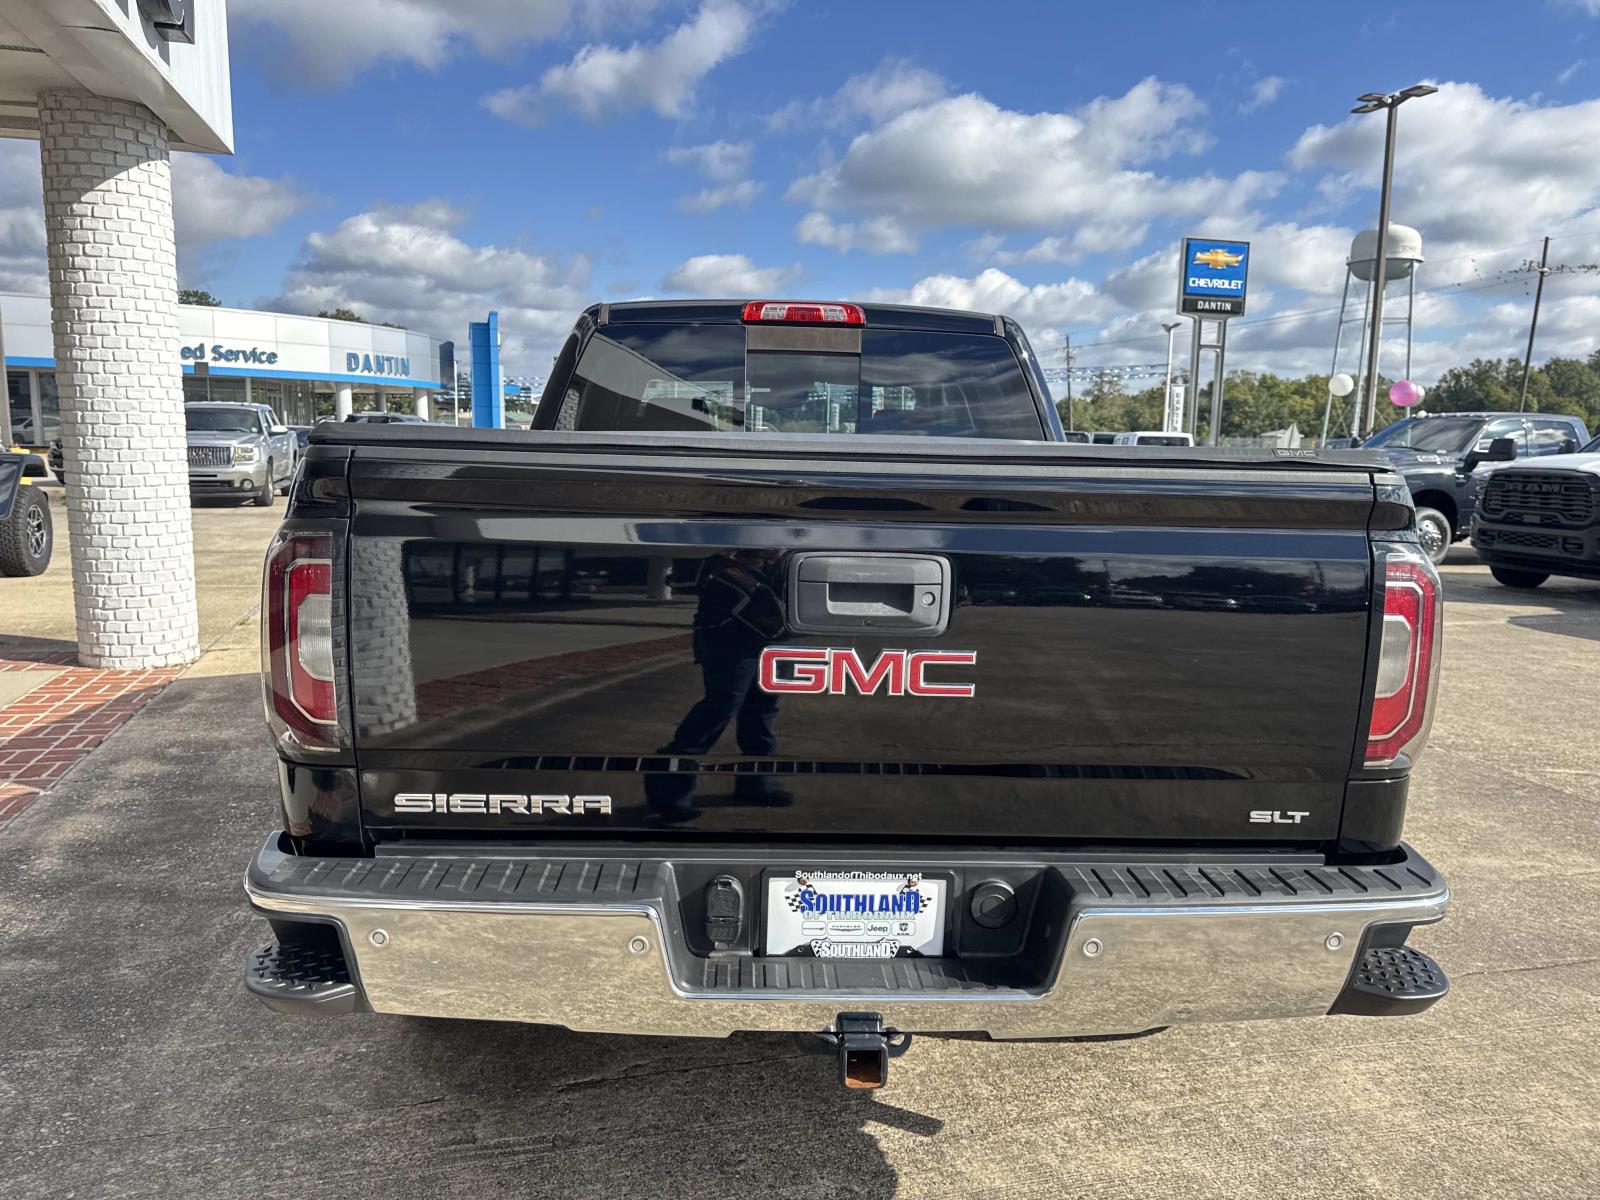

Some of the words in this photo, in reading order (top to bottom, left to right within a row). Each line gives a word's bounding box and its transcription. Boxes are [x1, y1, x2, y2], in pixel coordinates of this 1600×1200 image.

[1189, 277, 1243, 289] CHEVROLET
[1197, 301, 1232, 312] DANTIN
[210, 344, 278, 365] Service
[346, 352, 411, 377] DANTIN
[1509, 482, 1560, 493] RAM
[758, 645, 977, 698] GMC
[394, 793, 612, 815] SIERRA
[1249, 810, 1310, 824] SLT
[795, 870, 923, 880] SouthlandofThibodaux.net
[800, 890, 920, 915] SOUTHLAND
[867, 924, 888, 933] Jeep
[821, 941, 893, 958] SOUTHLAND
